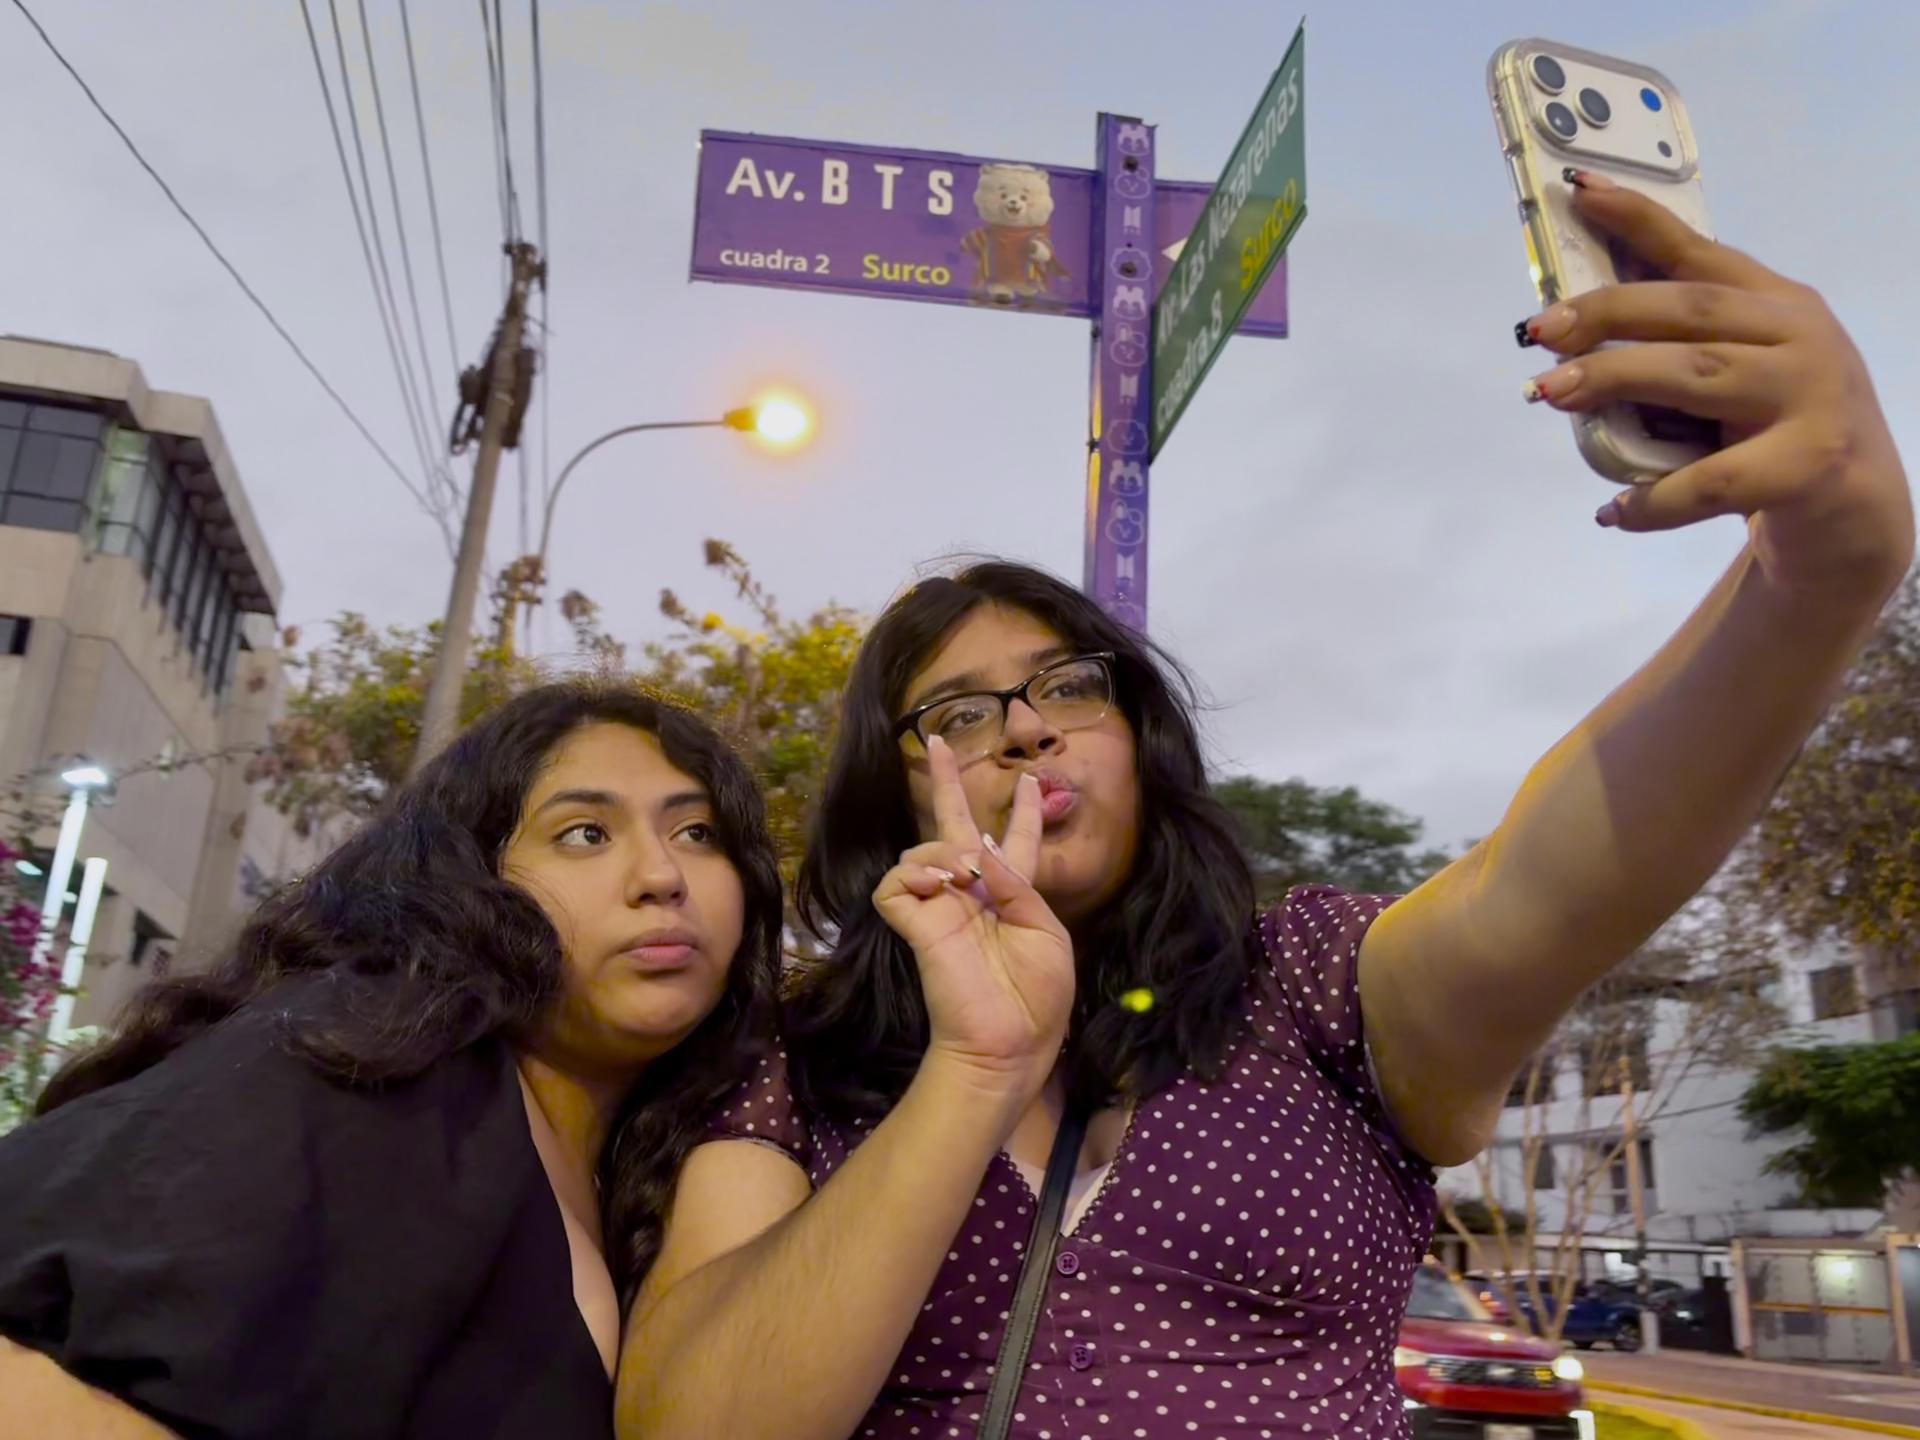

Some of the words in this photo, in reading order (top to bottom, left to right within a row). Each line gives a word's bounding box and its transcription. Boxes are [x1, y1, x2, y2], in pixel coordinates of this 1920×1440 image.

[724, 157, 805, 202] Av.
[1180, 239, 1206, 312] Las
[1207, 67, 1298, 262] Nazarenas
[719, 249, 809, 273] cuadra
[814, 253, 831, 275] 2
[862, 253, 951, 286] Surco
[1239, 178, 1298, 290] Surco
[1156, 326, 1208, 433] cuadra
[1211, 289, 1223, 340] 8
